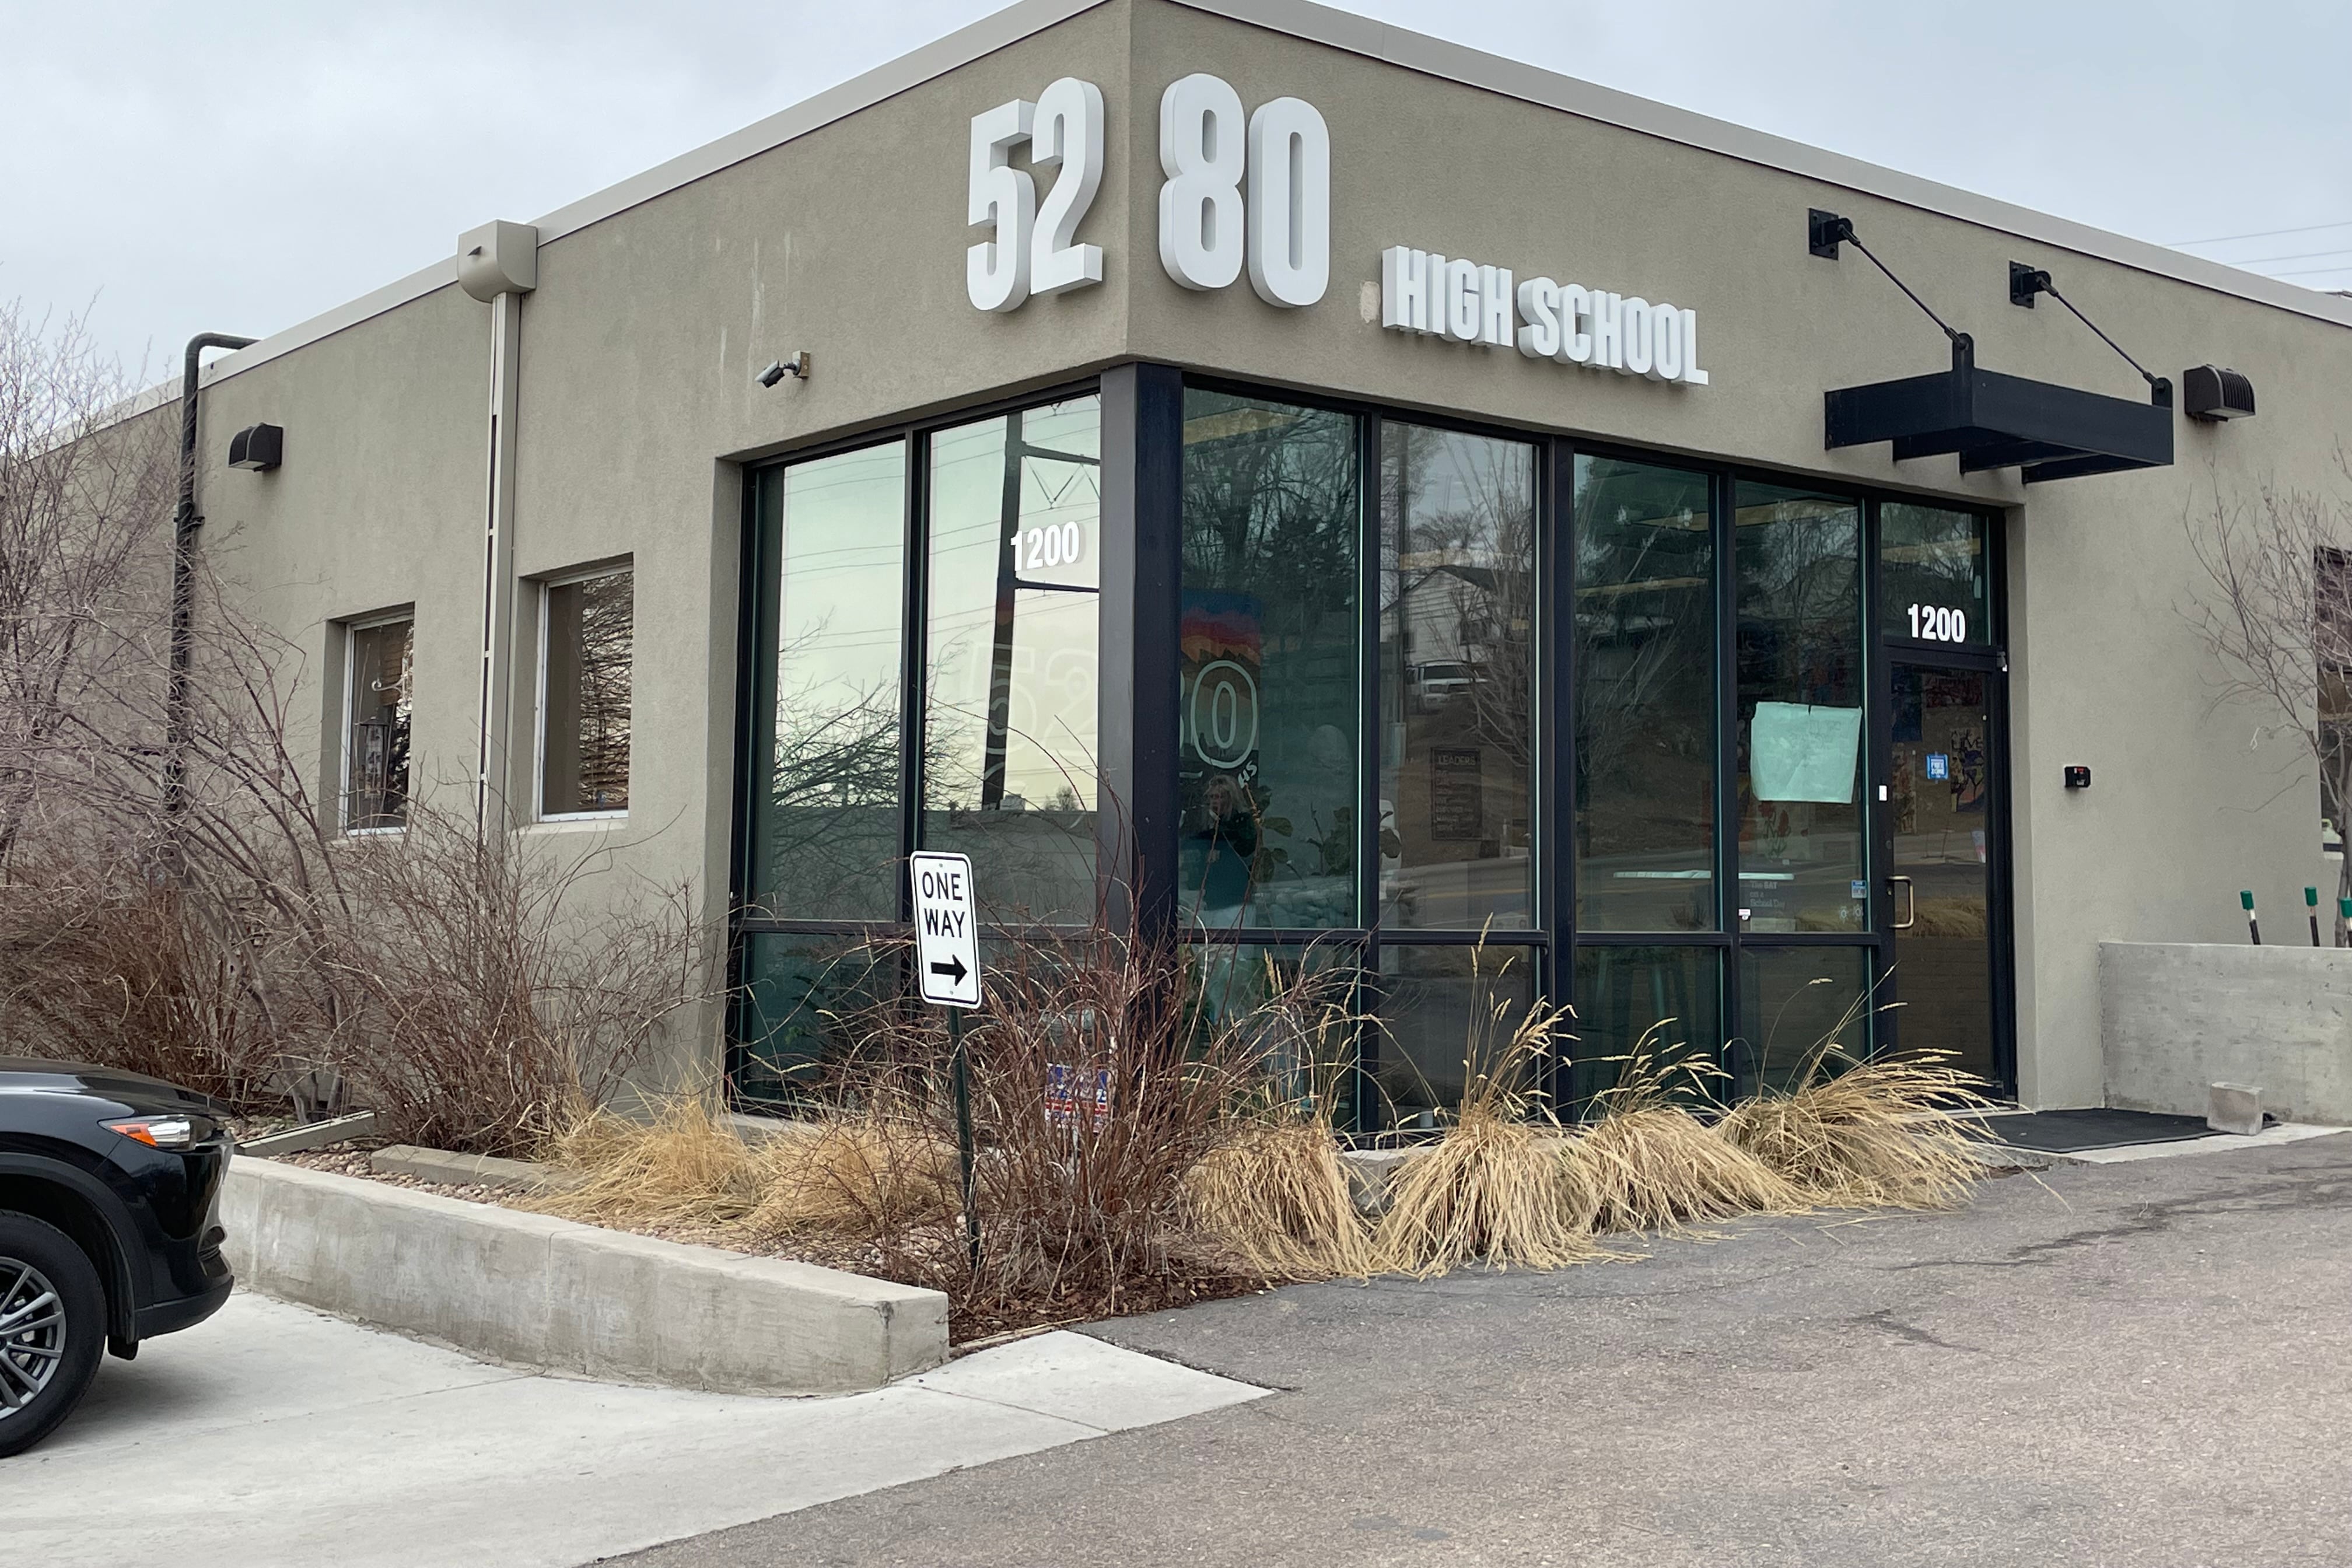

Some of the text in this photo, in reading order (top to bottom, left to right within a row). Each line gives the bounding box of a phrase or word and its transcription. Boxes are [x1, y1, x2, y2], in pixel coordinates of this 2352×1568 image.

[1382, 245, 1709, 386] HIGH SCHOOL
[1010, 521, 1080, 572] 1200
[1907, 603, 1966, 643] 1200
[1438, 755, 1476, 766] LEADERS
[922, 871, 964, 902] ONE
[923, 908, 965, 939] WAY
